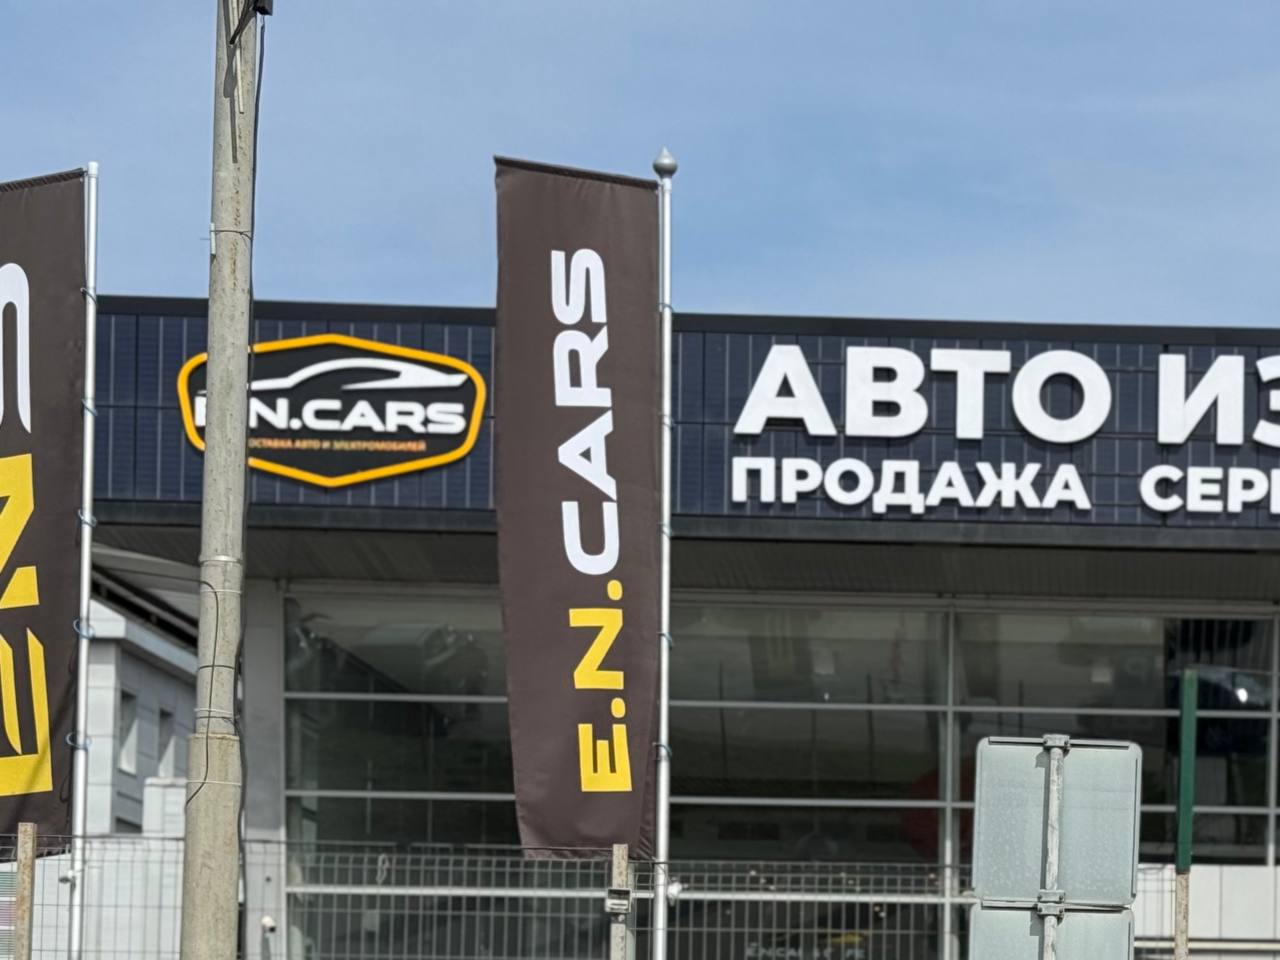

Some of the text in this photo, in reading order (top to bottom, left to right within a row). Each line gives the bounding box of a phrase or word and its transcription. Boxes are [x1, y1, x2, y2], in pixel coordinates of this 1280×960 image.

[195, 395, 467, 434] N.CARS
[733, 344, 1112, 444] АВТО
[551, 248, 632, 792] E.N.CARS
[731, 456, 1091, 514] ПРОДАЖА
